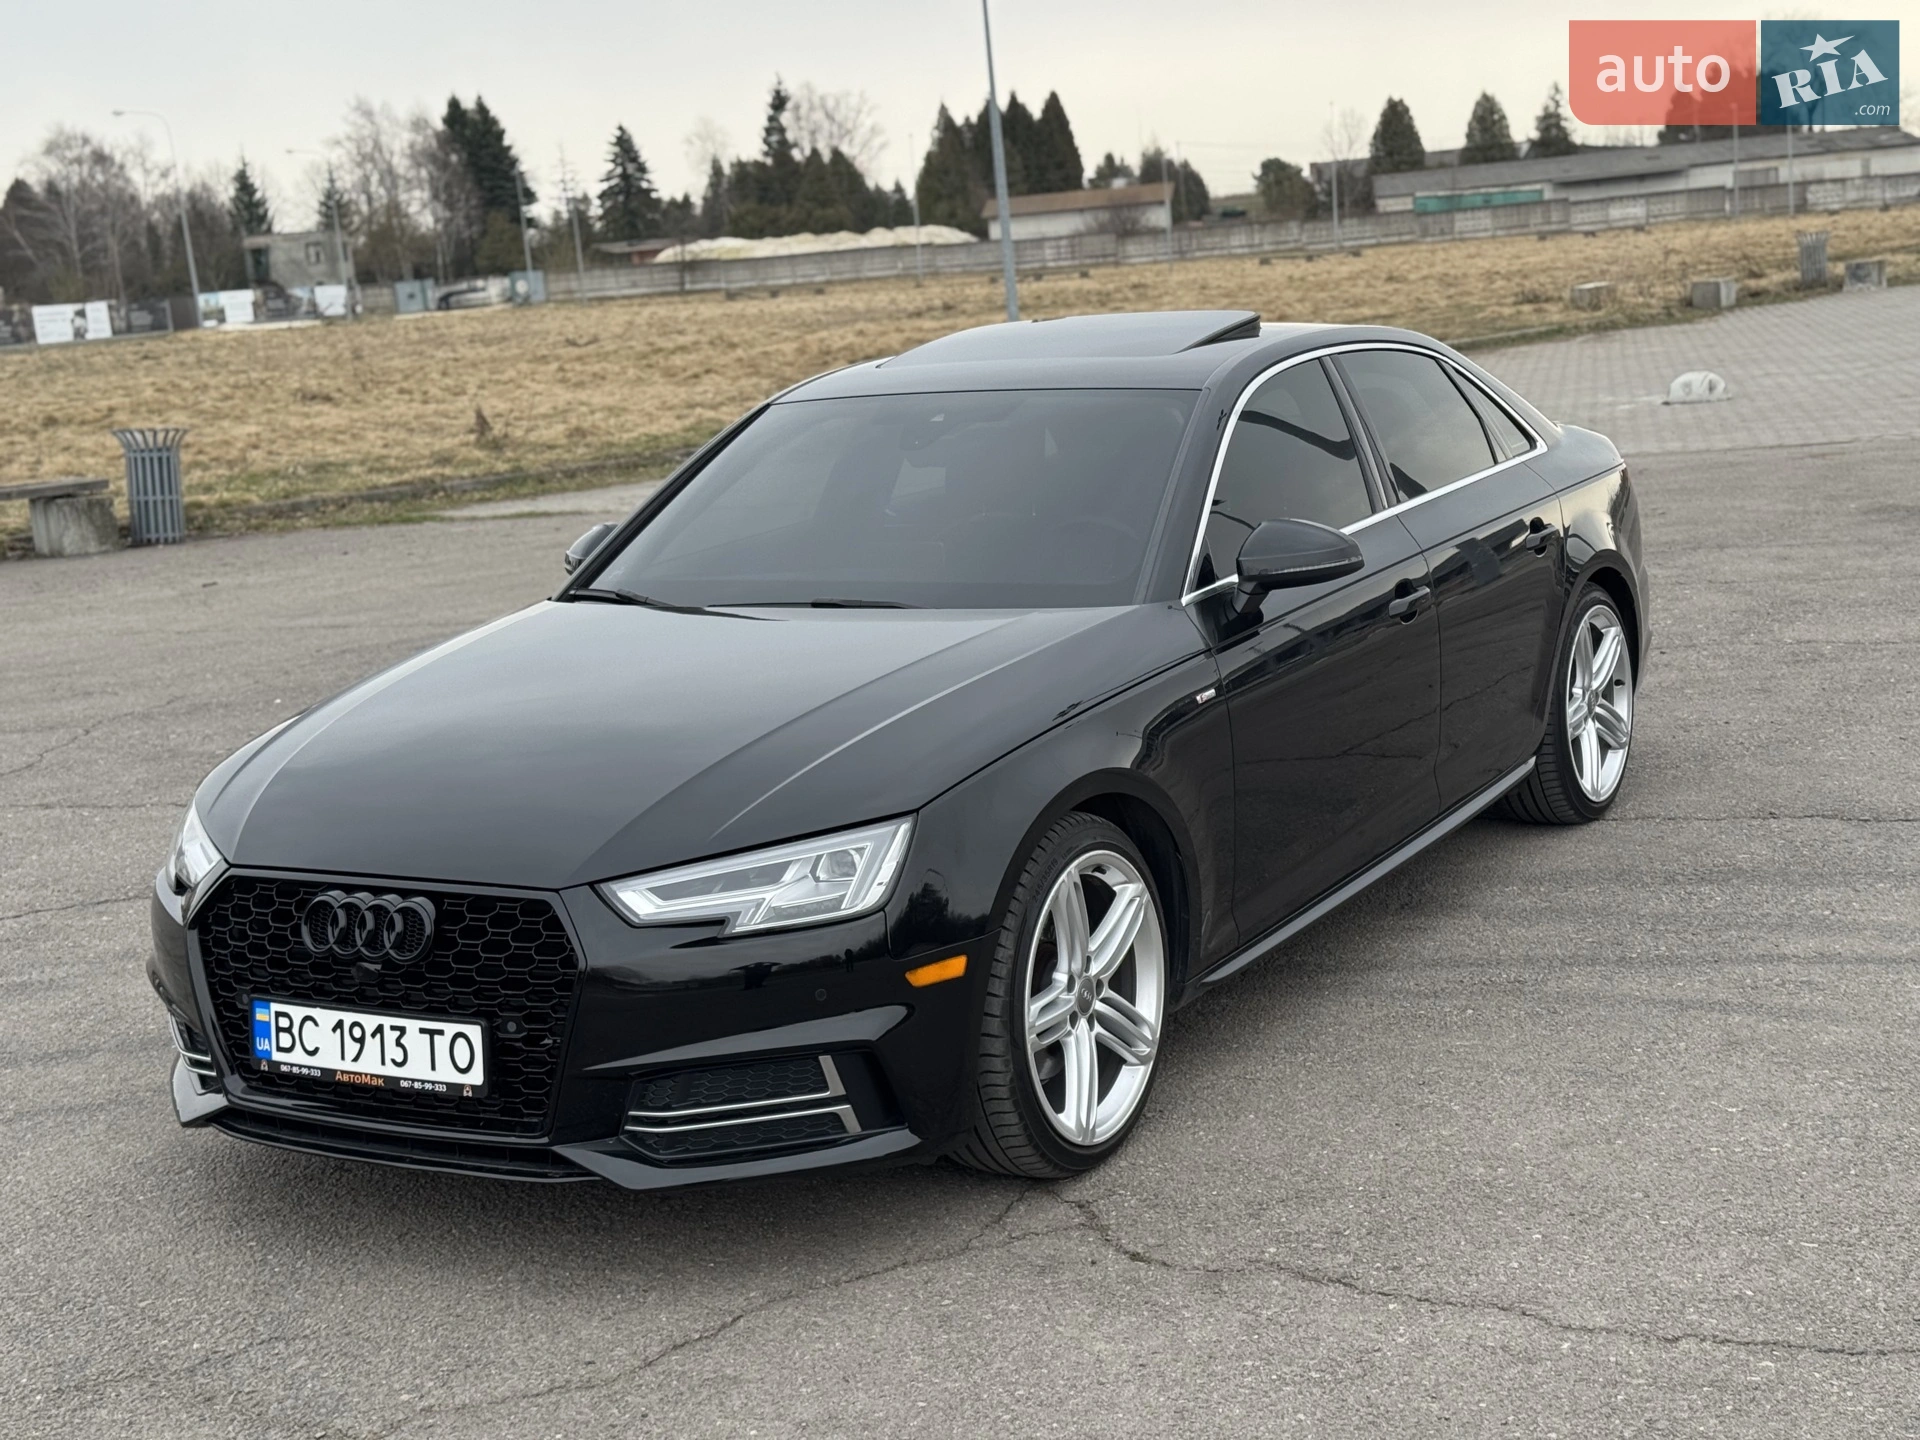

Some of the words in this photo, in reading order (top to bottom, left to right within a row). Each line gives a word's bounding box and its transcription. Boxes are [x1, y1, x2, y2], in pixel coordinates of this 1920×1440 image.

[256, 1036, 271, 1051] UA
[274, 1010, 321, 1057] BC
[331, 1018, 409, 1068] 1913
[419, 1027, 475, 1075] TO
[280, 1064, 321, 1077] 067-85-99-333
[335, 1070, 385, 1087] АвтоМак
[400, 1080, 447, 1092] 067-85-99-333
